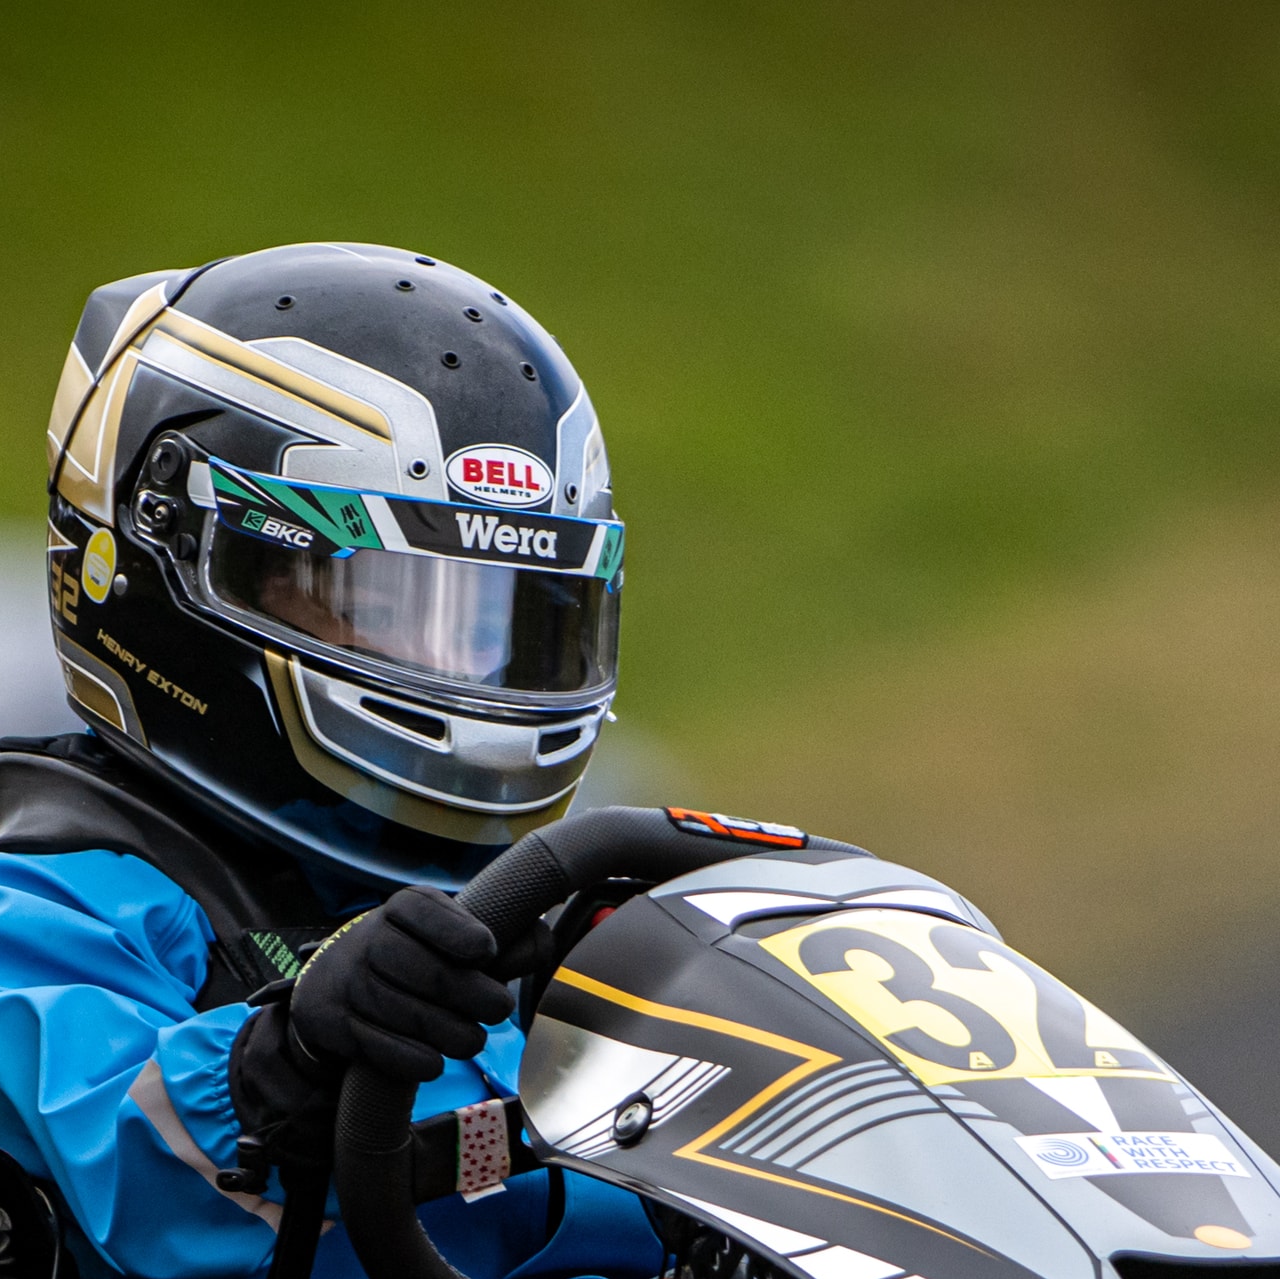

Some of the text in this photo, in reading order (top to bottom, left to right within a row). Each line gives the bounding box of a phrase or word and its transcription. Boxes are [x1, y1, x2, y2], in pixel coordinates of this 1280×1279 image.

[462, 458, 540, 491] BELL
[474, 486, 532, 498] HELMETS
[260, 521, 314, 547] BKC
[455, 512, 558, 559] Wera
[97, 628, 208, 715] HENRY EXTON
[798, 925, 1166, 1073] 32
[1111, 1135, 1177, 1146] RACE
[1121, 1147, 1190, 1158] WITH
[1133, 1159, 1237, 1173] RESPECT
